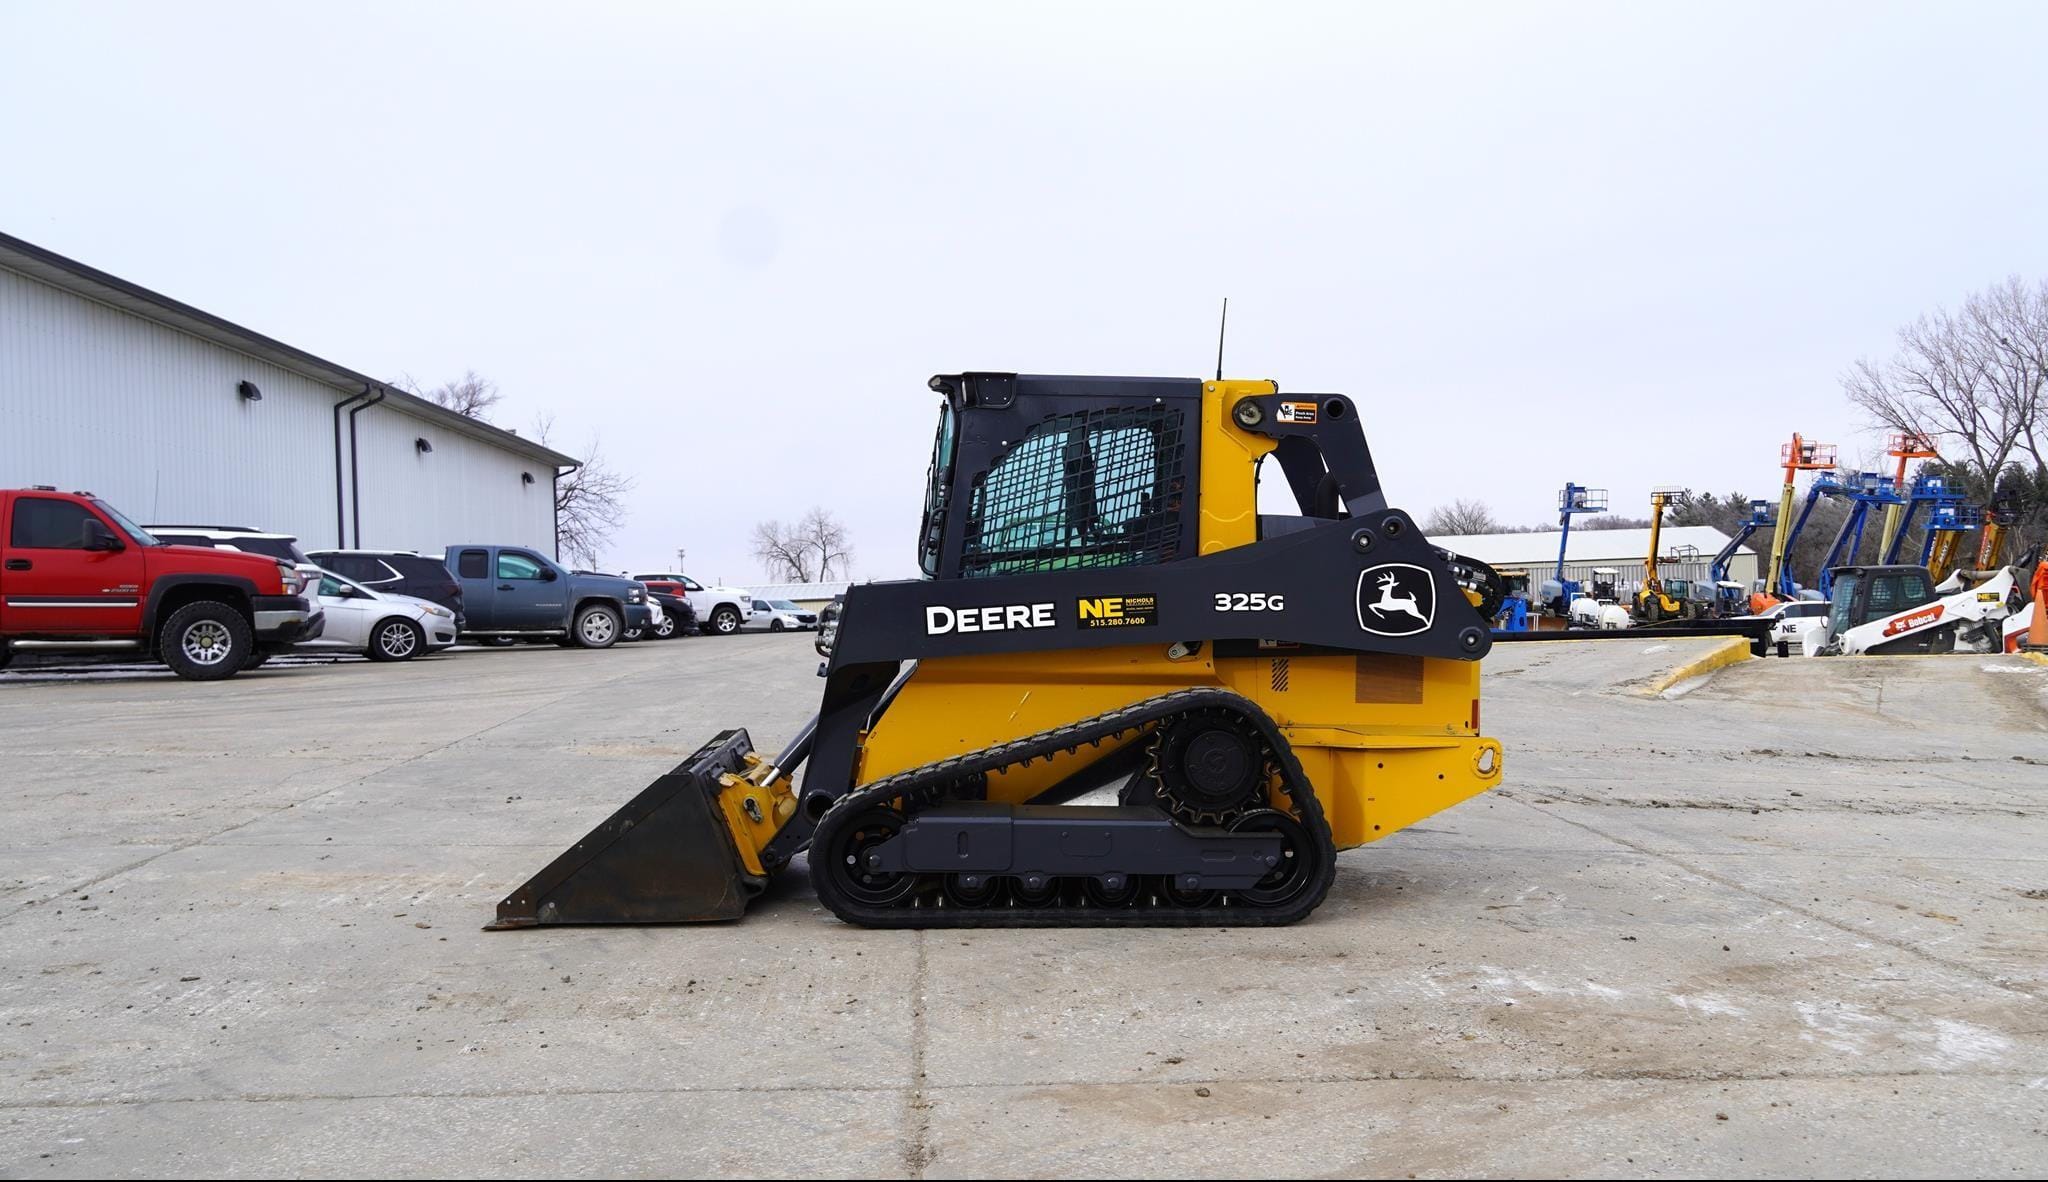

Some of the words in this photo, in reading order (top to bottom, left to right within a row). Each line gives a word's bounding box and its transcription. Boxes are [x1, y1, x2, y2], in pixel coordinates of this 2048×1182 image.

[1079, 598, 1124, 619] NE
[1215, 593, 1284, 611] 325G
[926, 603, 1056, 635] DEERE
[1090, 617, 1146, 627] 515.280.7600
[1908, 613, 1935, 627] Bobcat
[1782, 624, 1797, 633] NE
